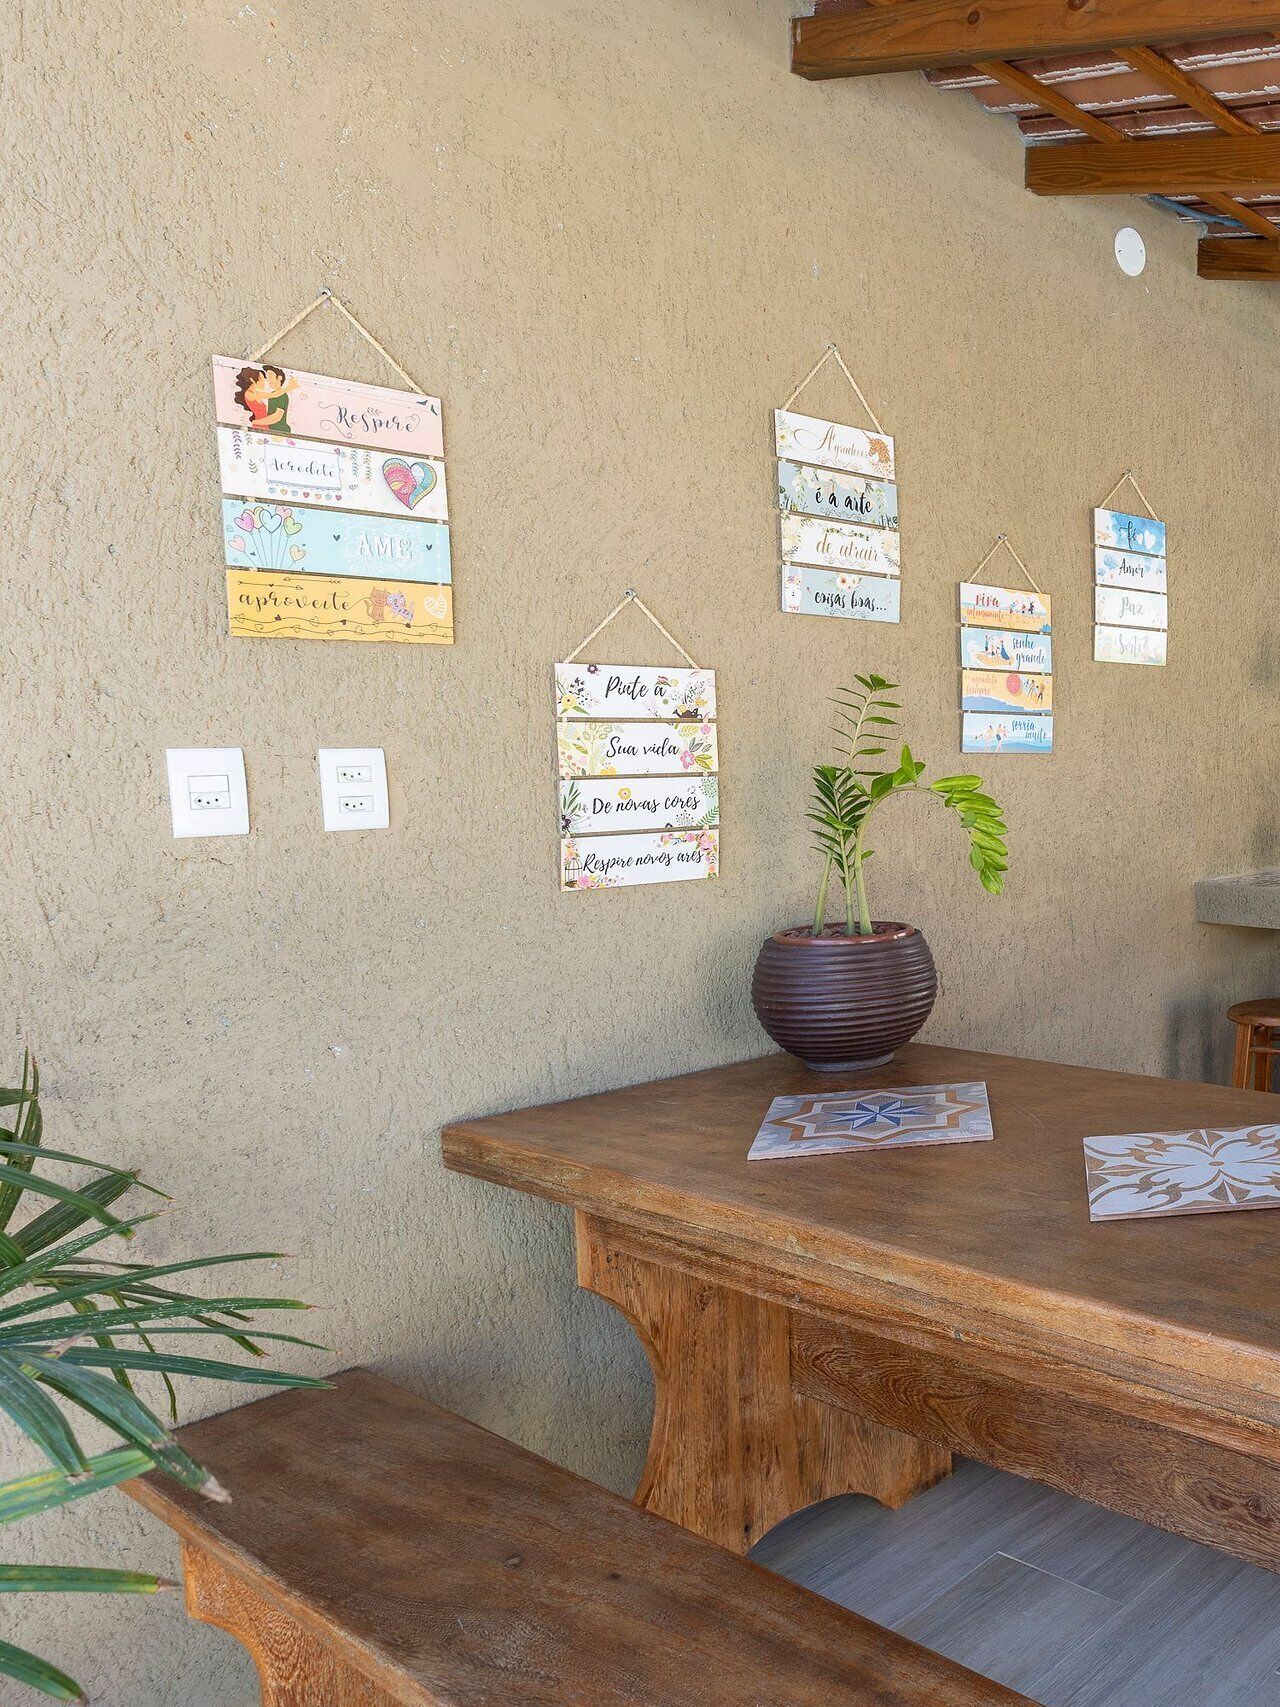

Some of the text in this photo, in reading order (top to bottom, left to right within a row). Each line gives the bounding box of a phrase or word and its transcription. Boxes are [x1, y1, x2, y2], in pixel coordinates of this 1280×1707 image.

[328, 404, 419, 435] Respire
[267, 456, 337, 480] Acredite
[815, 487, 873, 516] é a arte
[816, 534, 879, 563] de atrair
[1118, 557, 1145, 578] Amor
[238, 590, 352, 613] aproveite
[814, 591, 846, 609] coisas
[1015, 652, 1046, 670] grande
[605, 675, 668, 702] Pinte a
[605, 736, 680, 758] Sua vida
[592, 795, 701, 816] De novas cores
[583, 849, 705, 876] Respire novos ares
